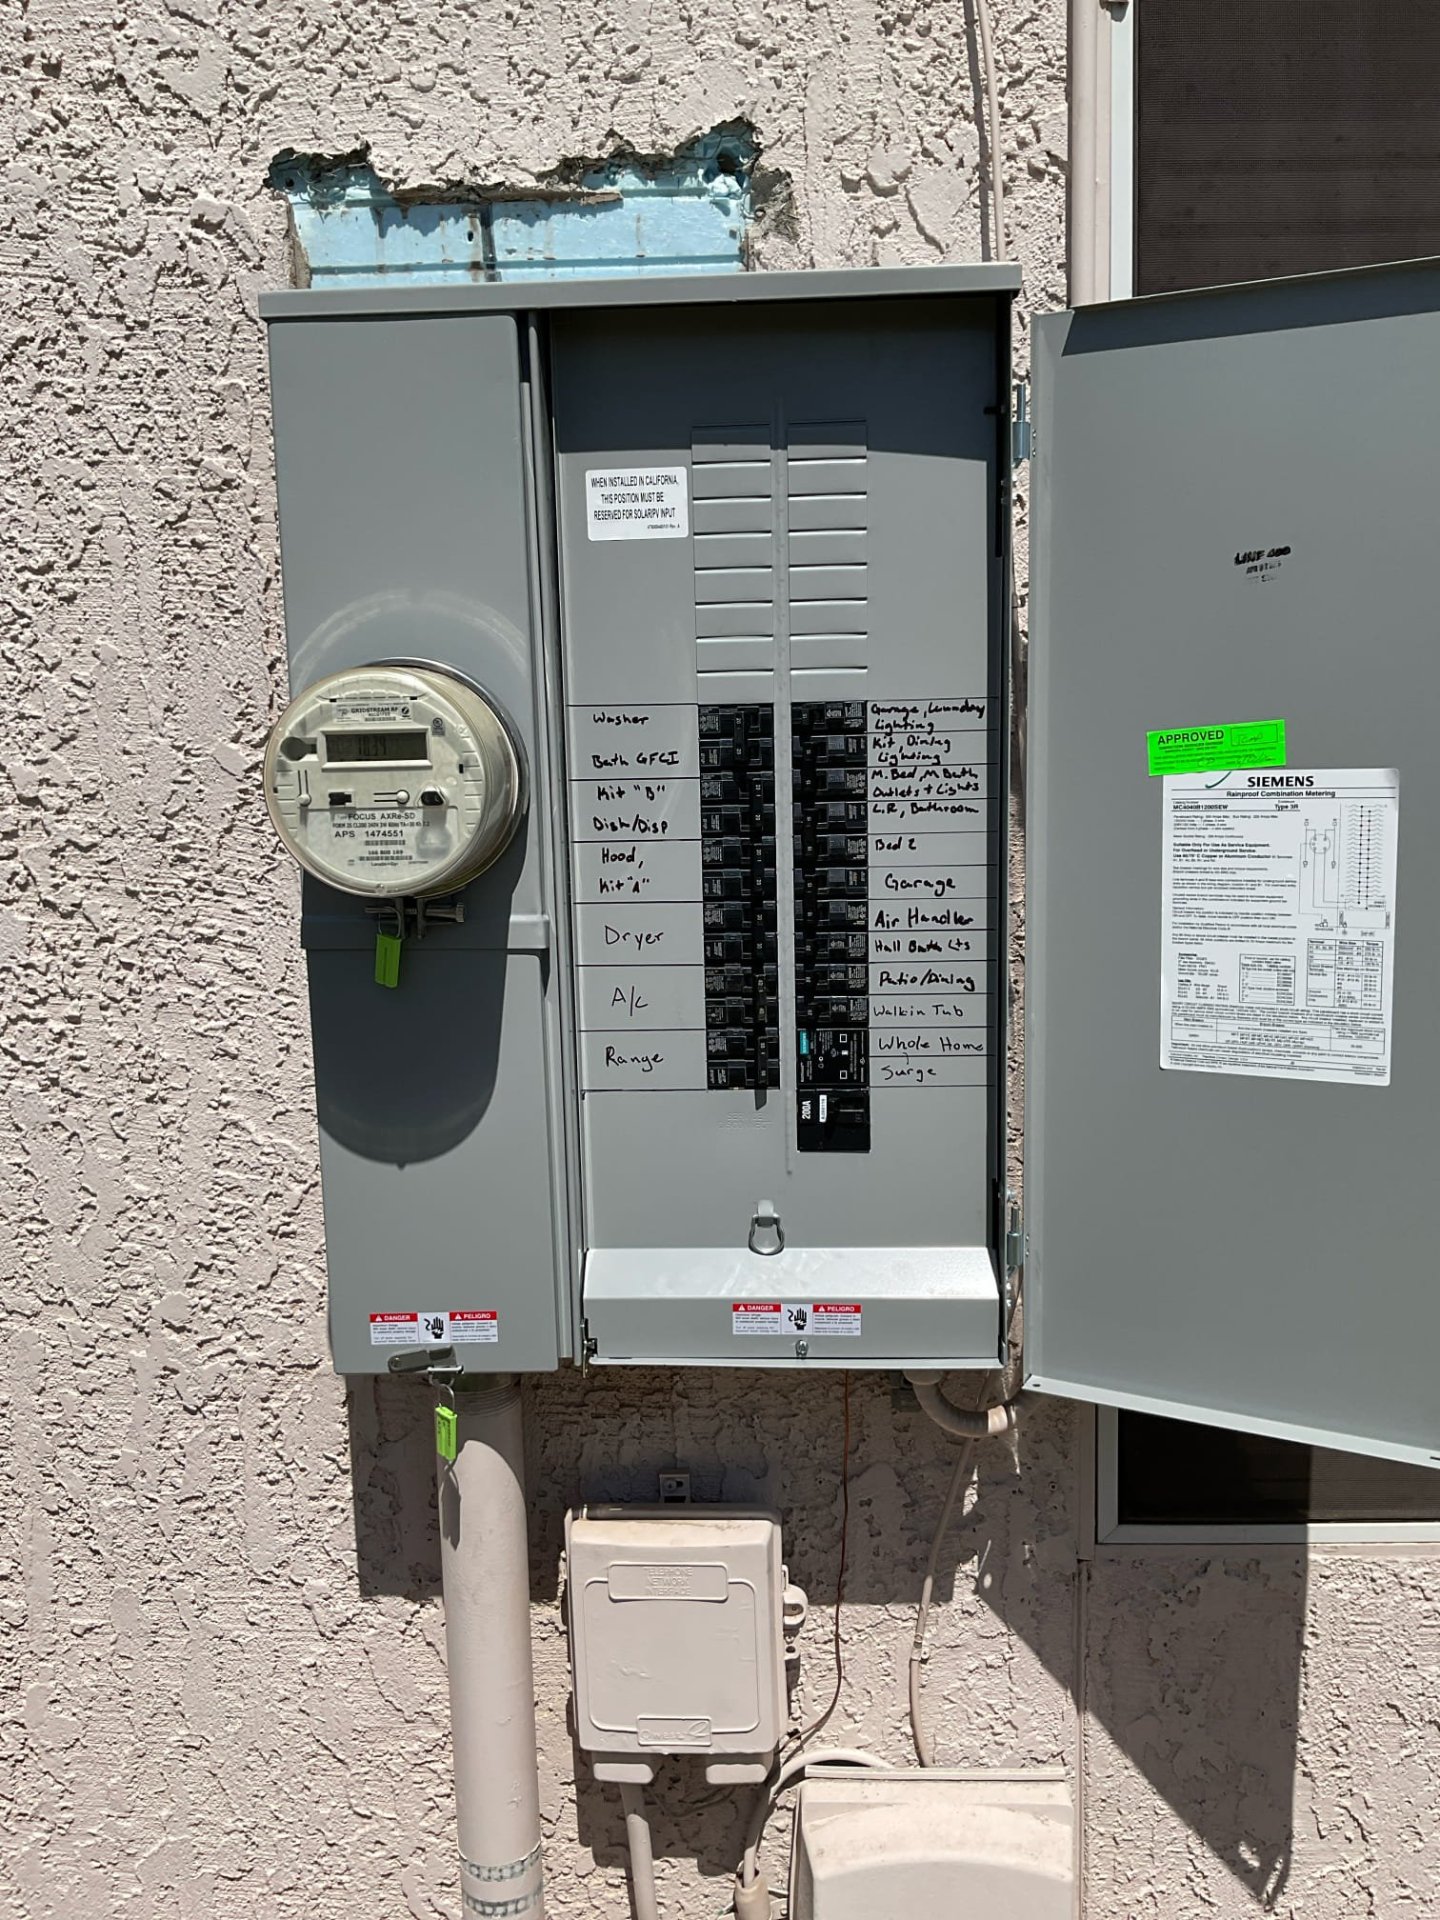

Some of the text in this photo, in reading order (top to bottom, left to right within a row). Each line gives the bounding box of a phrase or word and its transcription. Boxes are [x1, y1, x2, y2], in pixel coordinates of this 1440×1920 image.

[591, 478, 607, 488] WHEN
[608, 476, 637, 487] INSTALLED
[639, 476, 645, 486] IN
[601, 492, 664, 504] THIS POSITION MUST BE
[594, 510, 621, 521] RESERVED
[622, 509, 633, 520] FOR
[661, 507, 676, 518] INPUT
[593, 713, 650, 726] Washer
[875, 719, 935, 737] Lighting
[907, 735, 951, 754] Dining
[1158, 730, 1224, 745] APPROVED
[592, 751, 680, 769] Bath GFCI
[878, 751, 941, 767] Lighting
[943, 767, 978, 779] Bath
[872, 785, 920, 798] Outlets
[936, 781, 979, 796] Lights
[1248, 776, 1314, 787] SIEMENS
[597, 785, 626, 801] Kit
[1226, 790, 1259, 798] Rainproof
[1305, 790, 1336, 798] Metering
[910, 802, 979, 814] Bathroom
[875, 836, 903, 851] Bed
[600, 878, 624, 894] Kit
[885, 873, 956, 897] Garage
[875, 906, 974, 929] Air Handler
[604, 925, 665, 951] Dryer
[875, 940, 901, 953] Hall
[880, 969, 975, 992] Patio/Dining
[932, 1004, 964, 1017] Tub
[879, 1036, 984, 1052] Whole Home
[605, 1045, 665, 1073] Range
[881, 1065, 937, 1083] Surge
[802, 1100, 811, 1120] 200A
